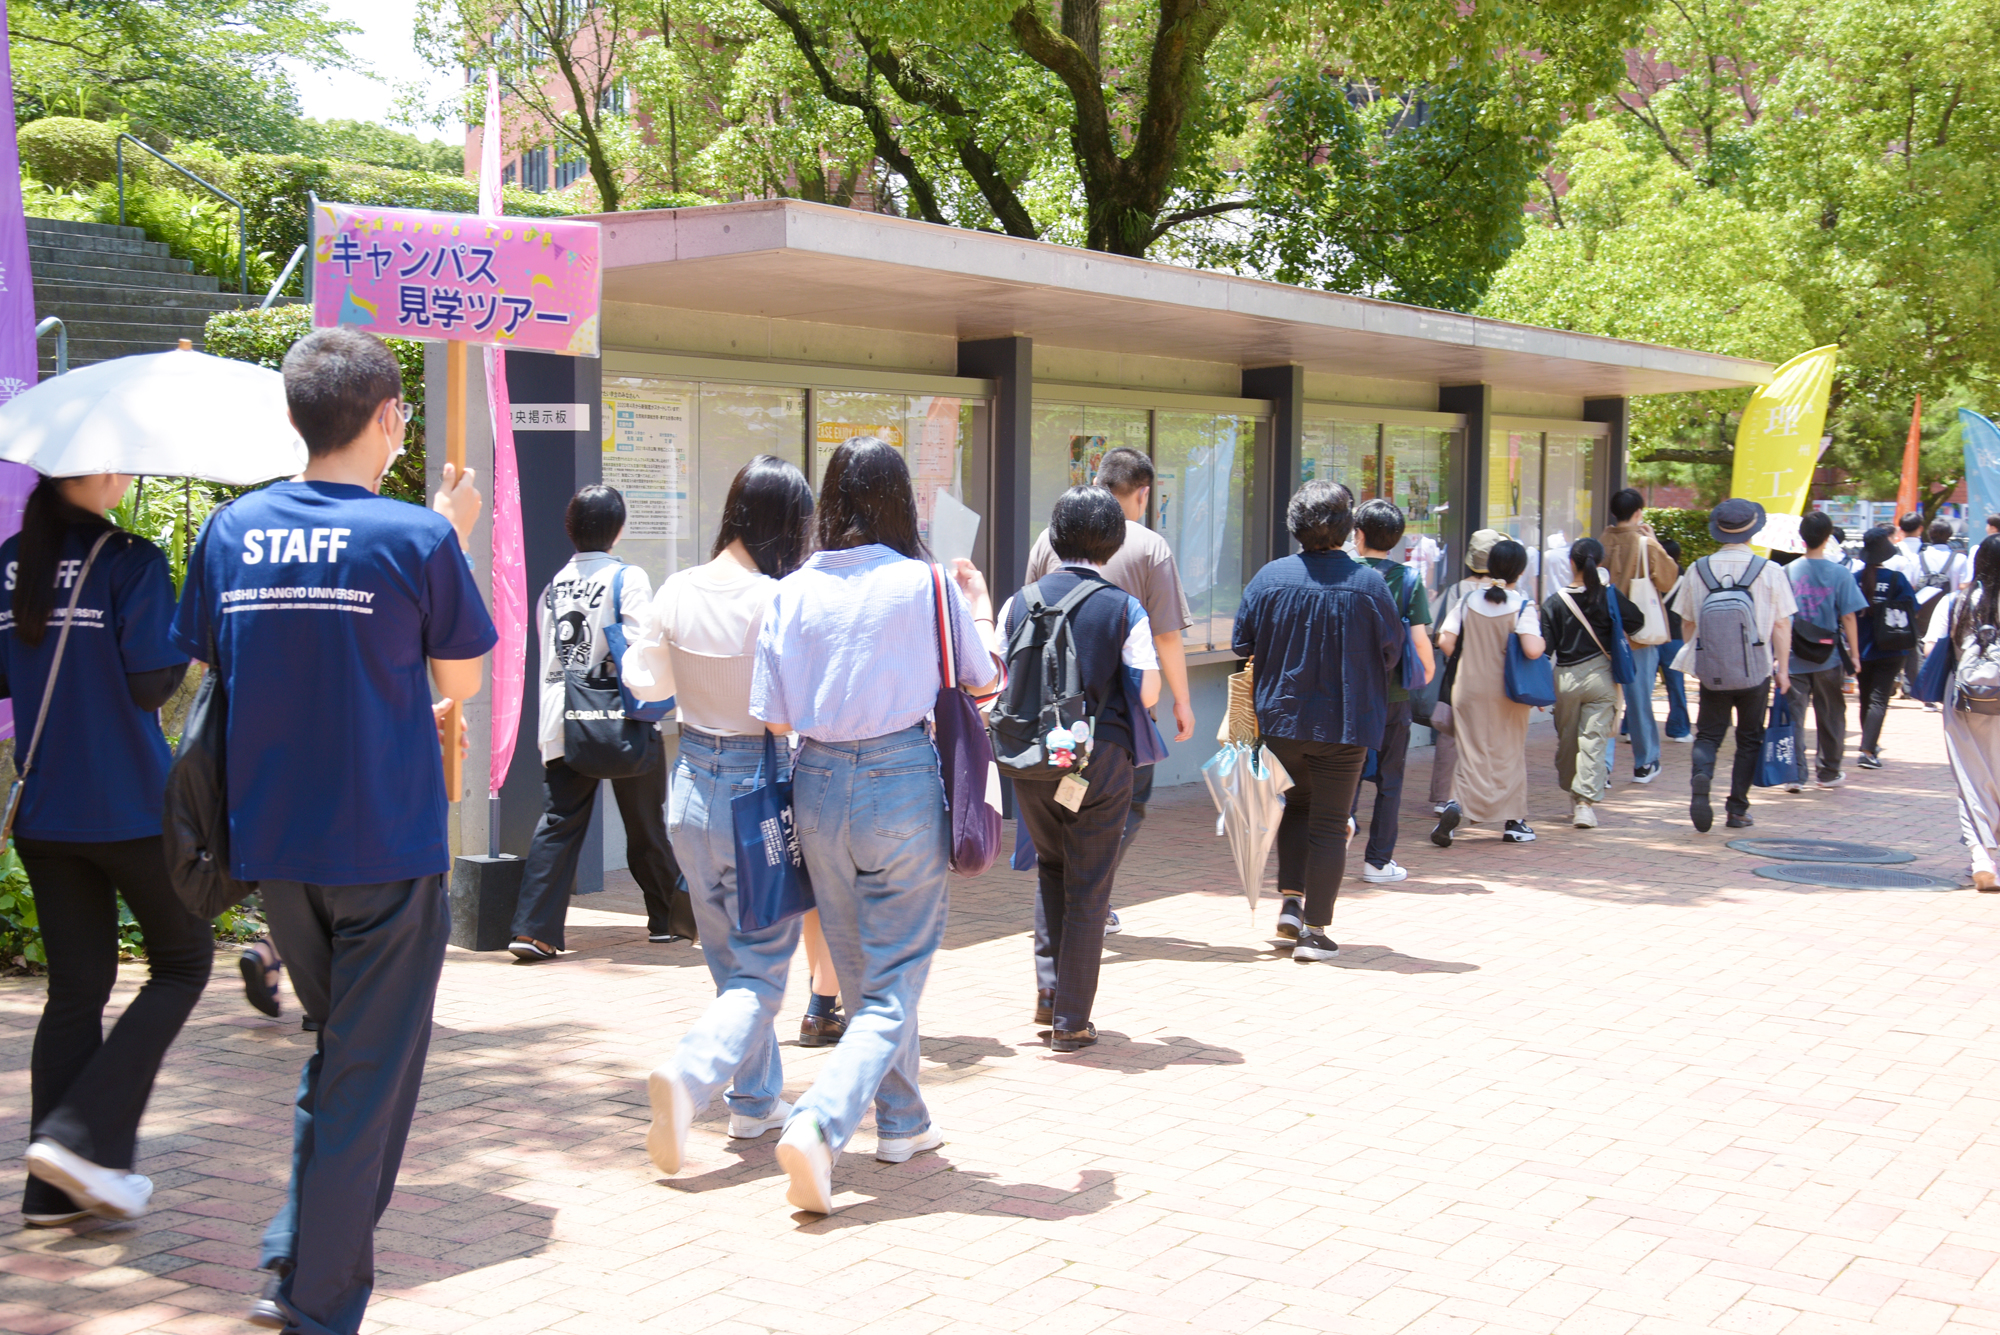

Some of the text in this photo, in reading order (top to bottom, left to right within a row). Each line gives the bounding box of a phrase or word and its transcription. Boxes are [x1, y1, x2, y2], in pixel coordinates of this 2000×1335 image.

[353, 217, 553, 244] CAMPUS TOUR
[332, 233, 498, 285] キャンパス
[397, 285, 570, 333] 見学ツアー
[510, 409, 567, 424] 央掲示板
[242, 528, 351, 565] STAFF
[4, 560, 82, 591] SFF
[259, 587, 307, 599] SANGYO
[308, 587, 375, 603] UNIVERSITY
[565, 709, 608, 720] GOBAL
